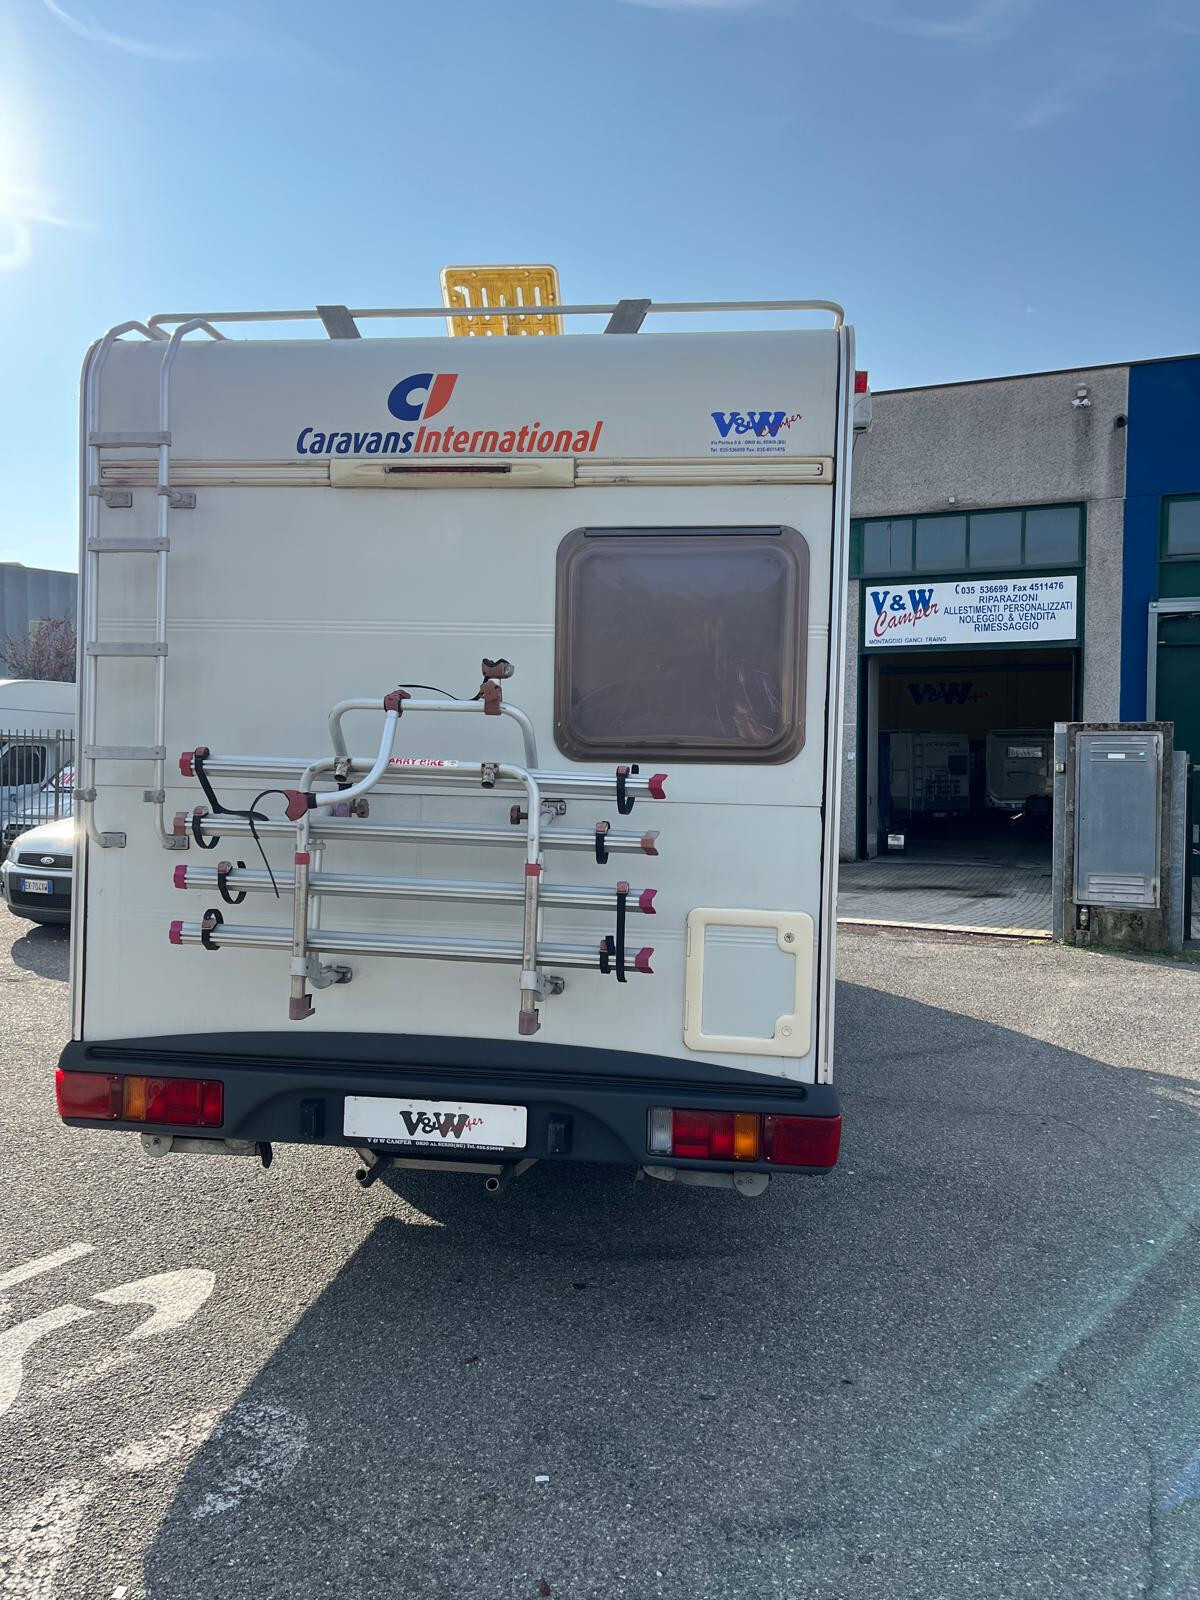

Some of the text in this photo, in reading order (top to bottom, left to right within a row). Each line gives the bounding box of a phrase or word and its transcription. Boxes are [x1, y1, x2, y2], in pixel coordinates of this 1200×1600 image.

[413, 421, 604, 453] International
[961, 582, 1064, 594] 035 536699 Fax 4511476
[978, 593, 1038, 604] RIPARAZIONI
[943, 601, 1073, 615] ALLESTIMENTI PERSONALIZZATI
[873, 602, 939, 638] Camper
[959, 611, 1056, 624] NOLEGGIO & VENDITA
[974, 621, 1039, 632] RIMESSAGGIO
[868, 637, 903, 645] MONTAGGIO
[925, 635, 947, 643] TRAINO
